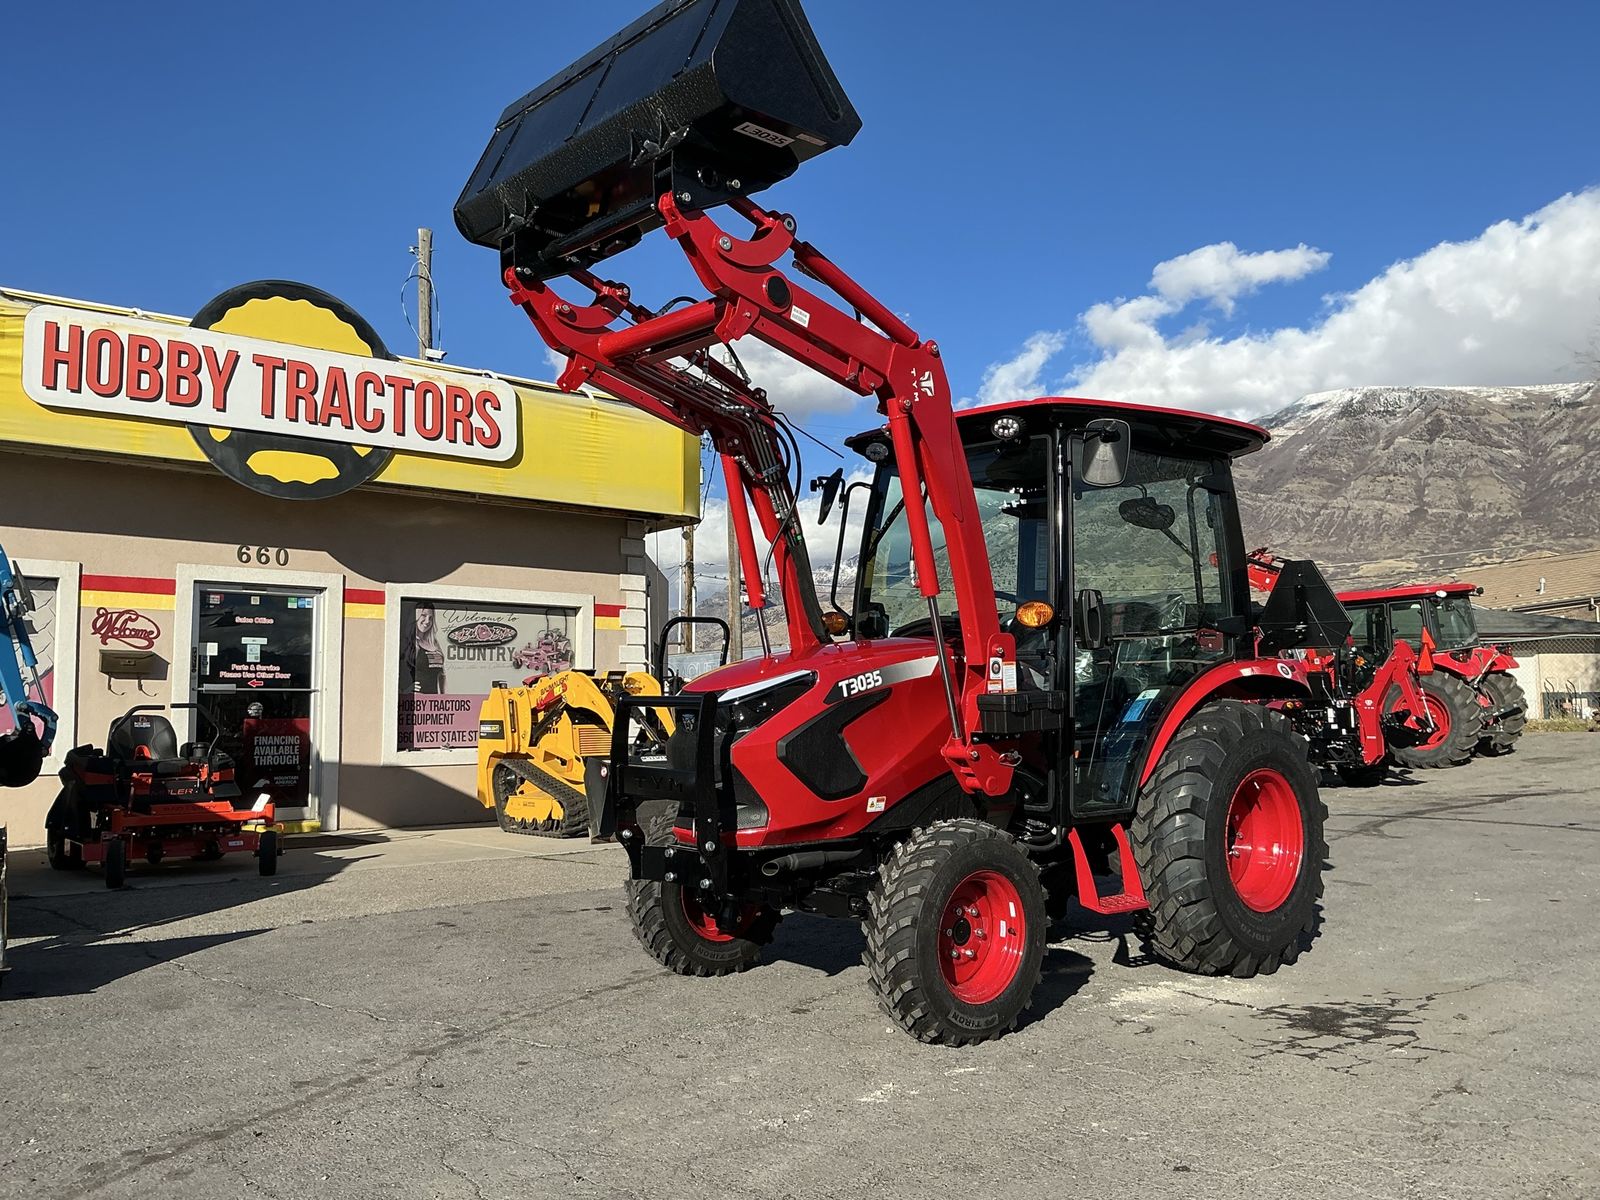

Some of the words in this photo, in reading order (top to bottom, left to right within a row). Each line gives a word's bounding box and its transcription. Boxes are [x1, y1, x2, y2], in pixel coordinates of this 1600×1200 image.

[739, 125, 788, 145] L3035
[41, 321, 240, 411] HOBBY
[252, 353, 502, 448] TRACTORS
[236, 544, 289, 566] 660
[443, 606, 503, 624] Welcome
[506, 612, 519, 623] to
[91, 607, 161, 650] Welcome
[447, 645, 516, 662] COUNTRY
[838, 670, 883, 698] T3035
[398, 699, 427, 712] HOBBY
[428, 699, 471, 712] TRACTORS
[406, 713, 455, 726] EQUIPMENT
[254, 735, 300, 746] FINANCING
[398, 731, 414, 743] 660
[416, 731, 440, 743] WEST
[441, 731, 467, 743] STATE
[468, 730, 478, 742] ST
[254, 745, 300, 756] AVAILABLE
[254, 755, 299, 766] THROUGH
